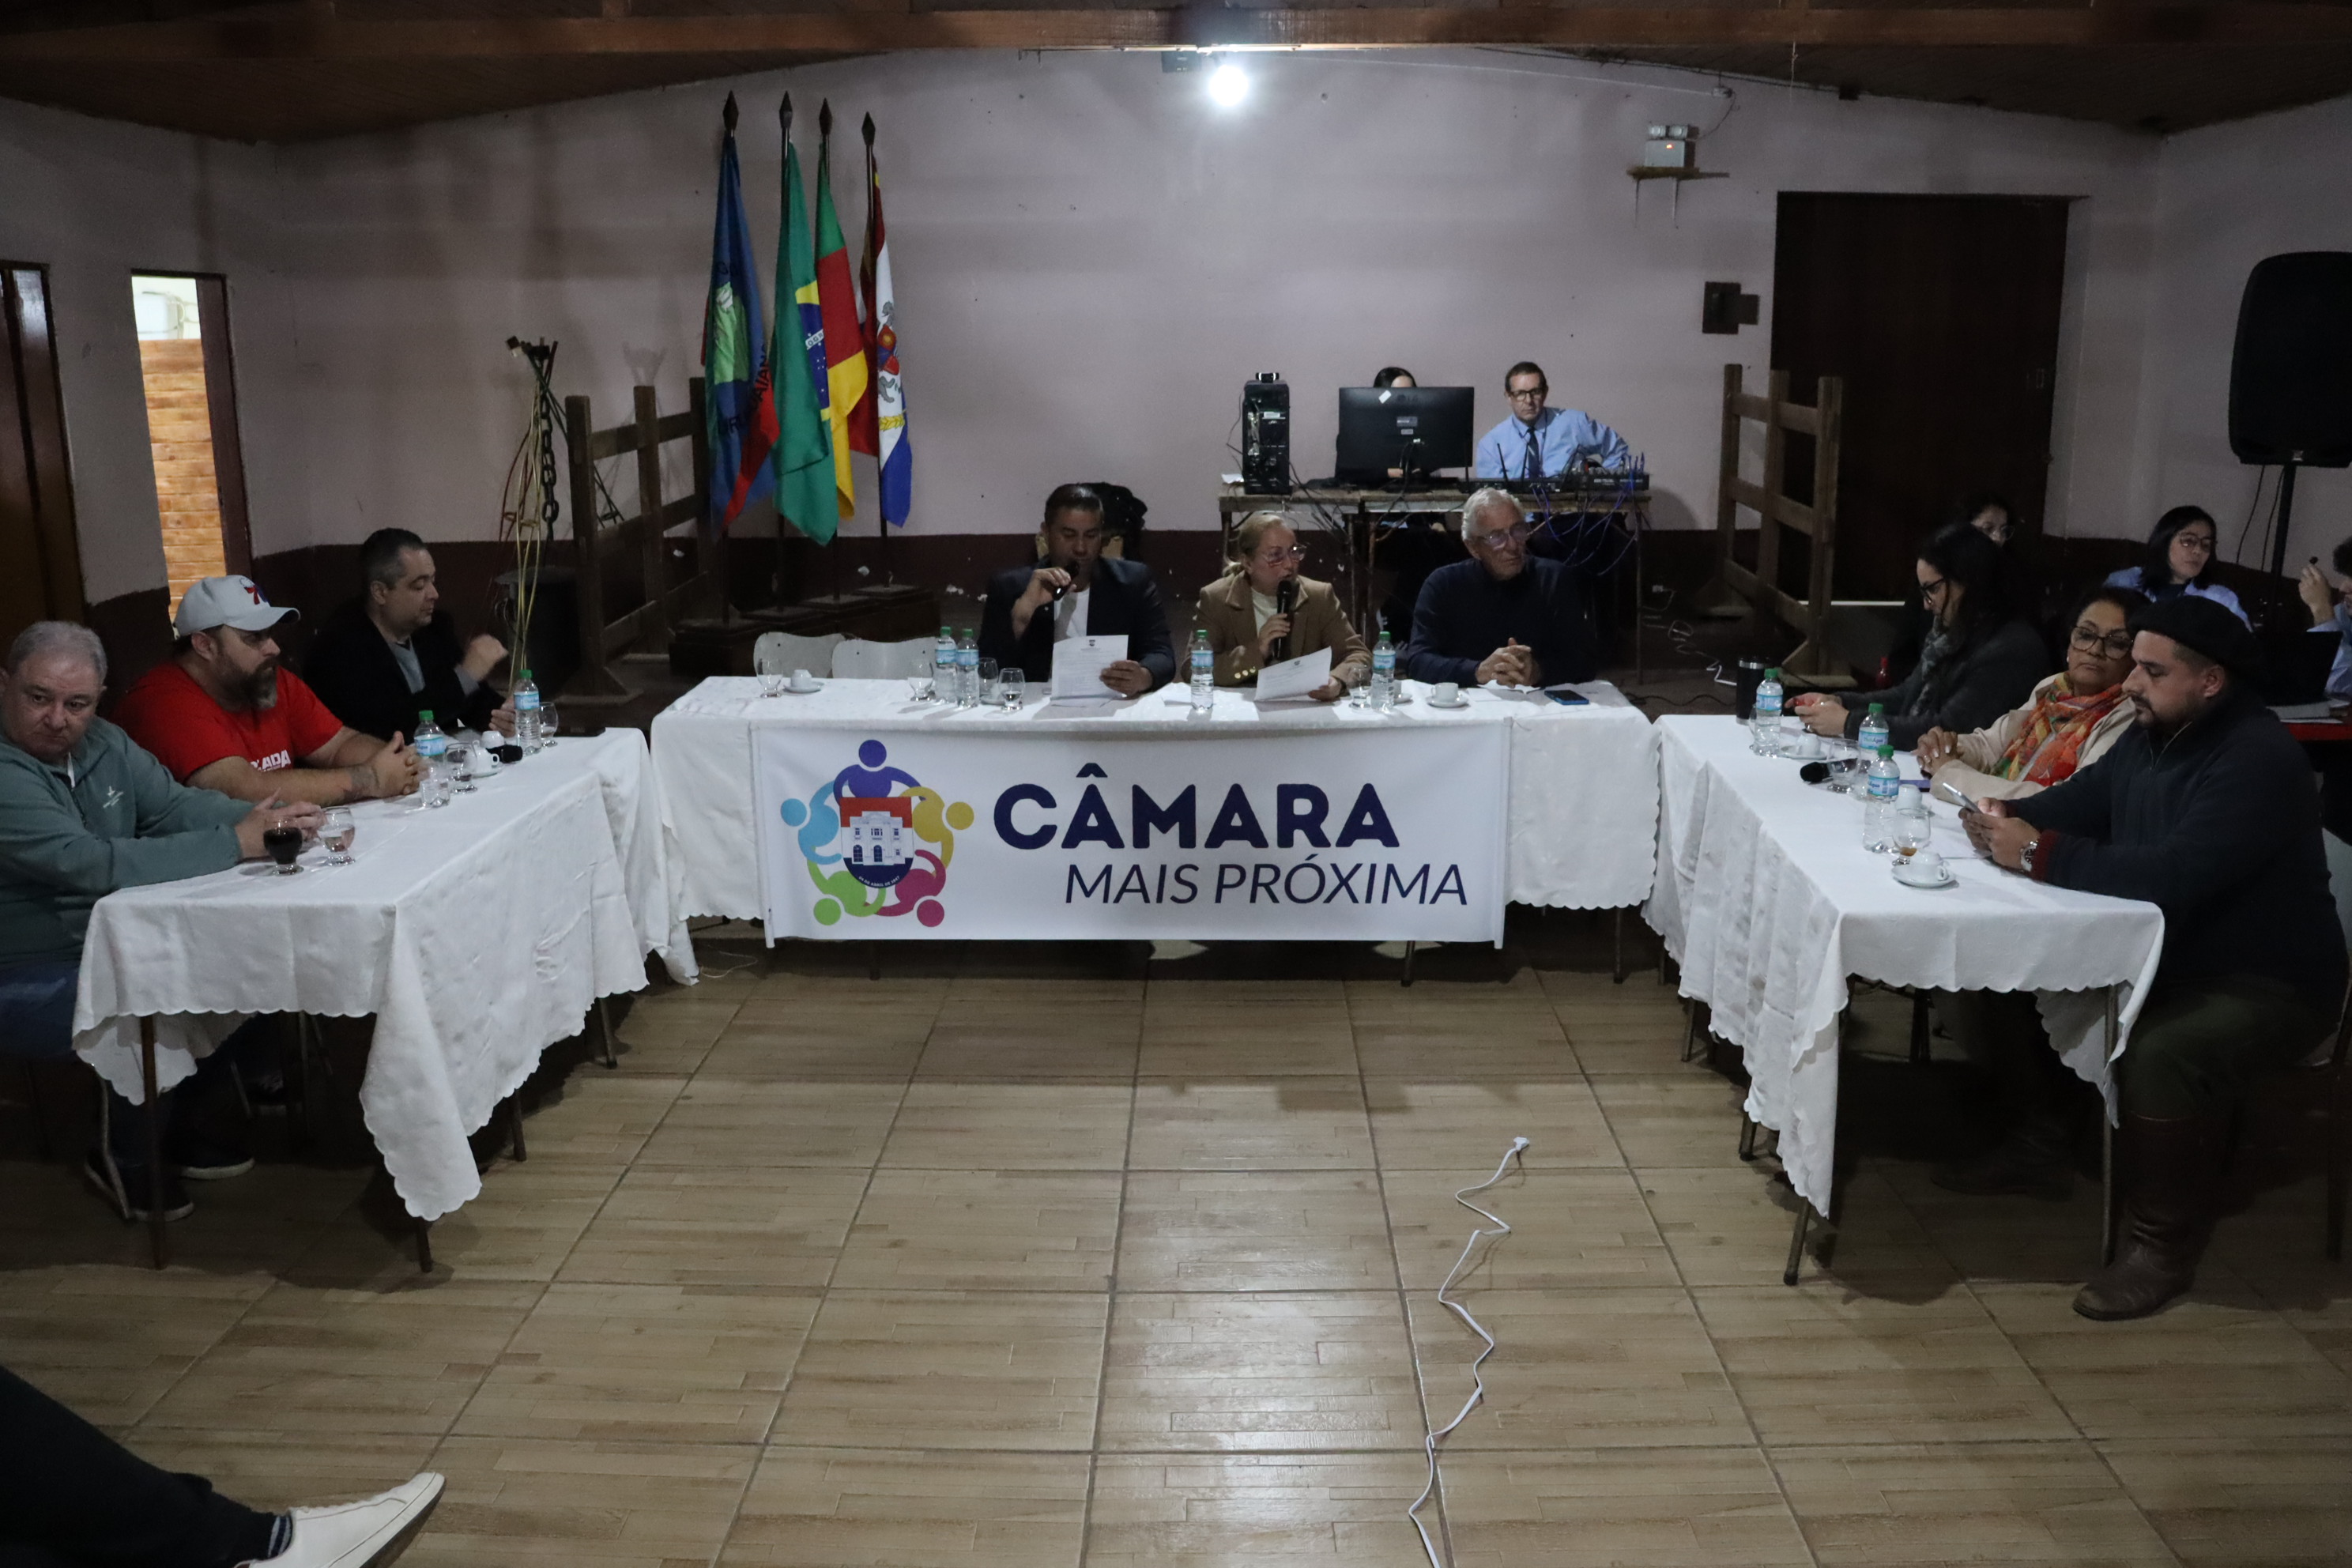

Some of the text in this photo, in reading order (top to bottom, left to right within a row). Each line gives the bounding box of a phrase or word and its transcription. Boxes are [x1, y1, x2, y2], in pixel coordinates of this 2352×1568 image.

[993, 762, 1400, 850] CÂMARA
[1065, 854, 1468, 906] MAIS PRÓXIMA
